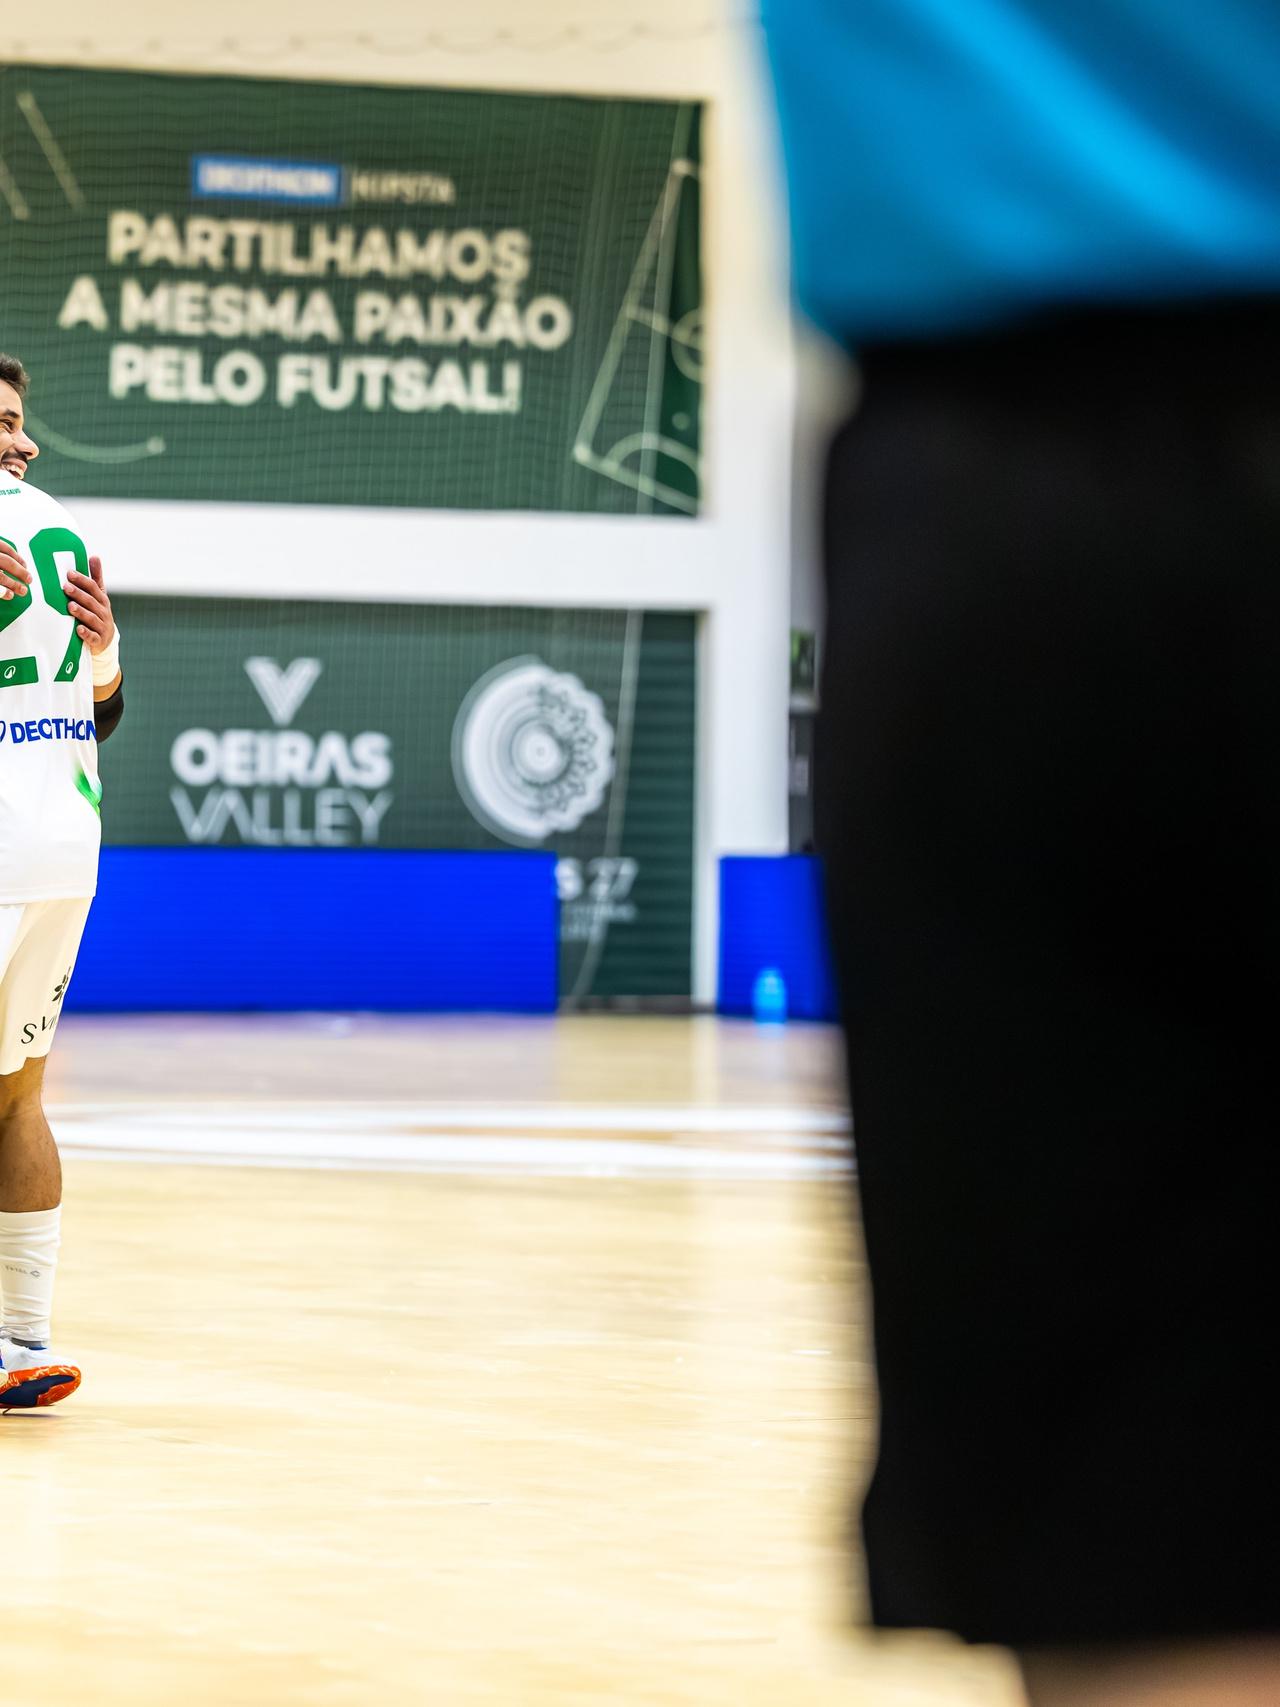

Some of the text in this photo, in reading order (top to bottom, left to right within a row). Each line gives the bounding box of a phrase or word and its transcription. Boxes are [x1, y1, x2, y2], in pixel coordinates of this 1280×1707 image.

[107, 209, 531, 282] PARTILHAMOS
[57, 275, 573, 350] A MESMA PAIXÃO
[109, 342, 521, 414] PELO FUTSAL!
[170, 727, 394, 789] OEIRAS
[169, 786, 395, 846] VALLEY
